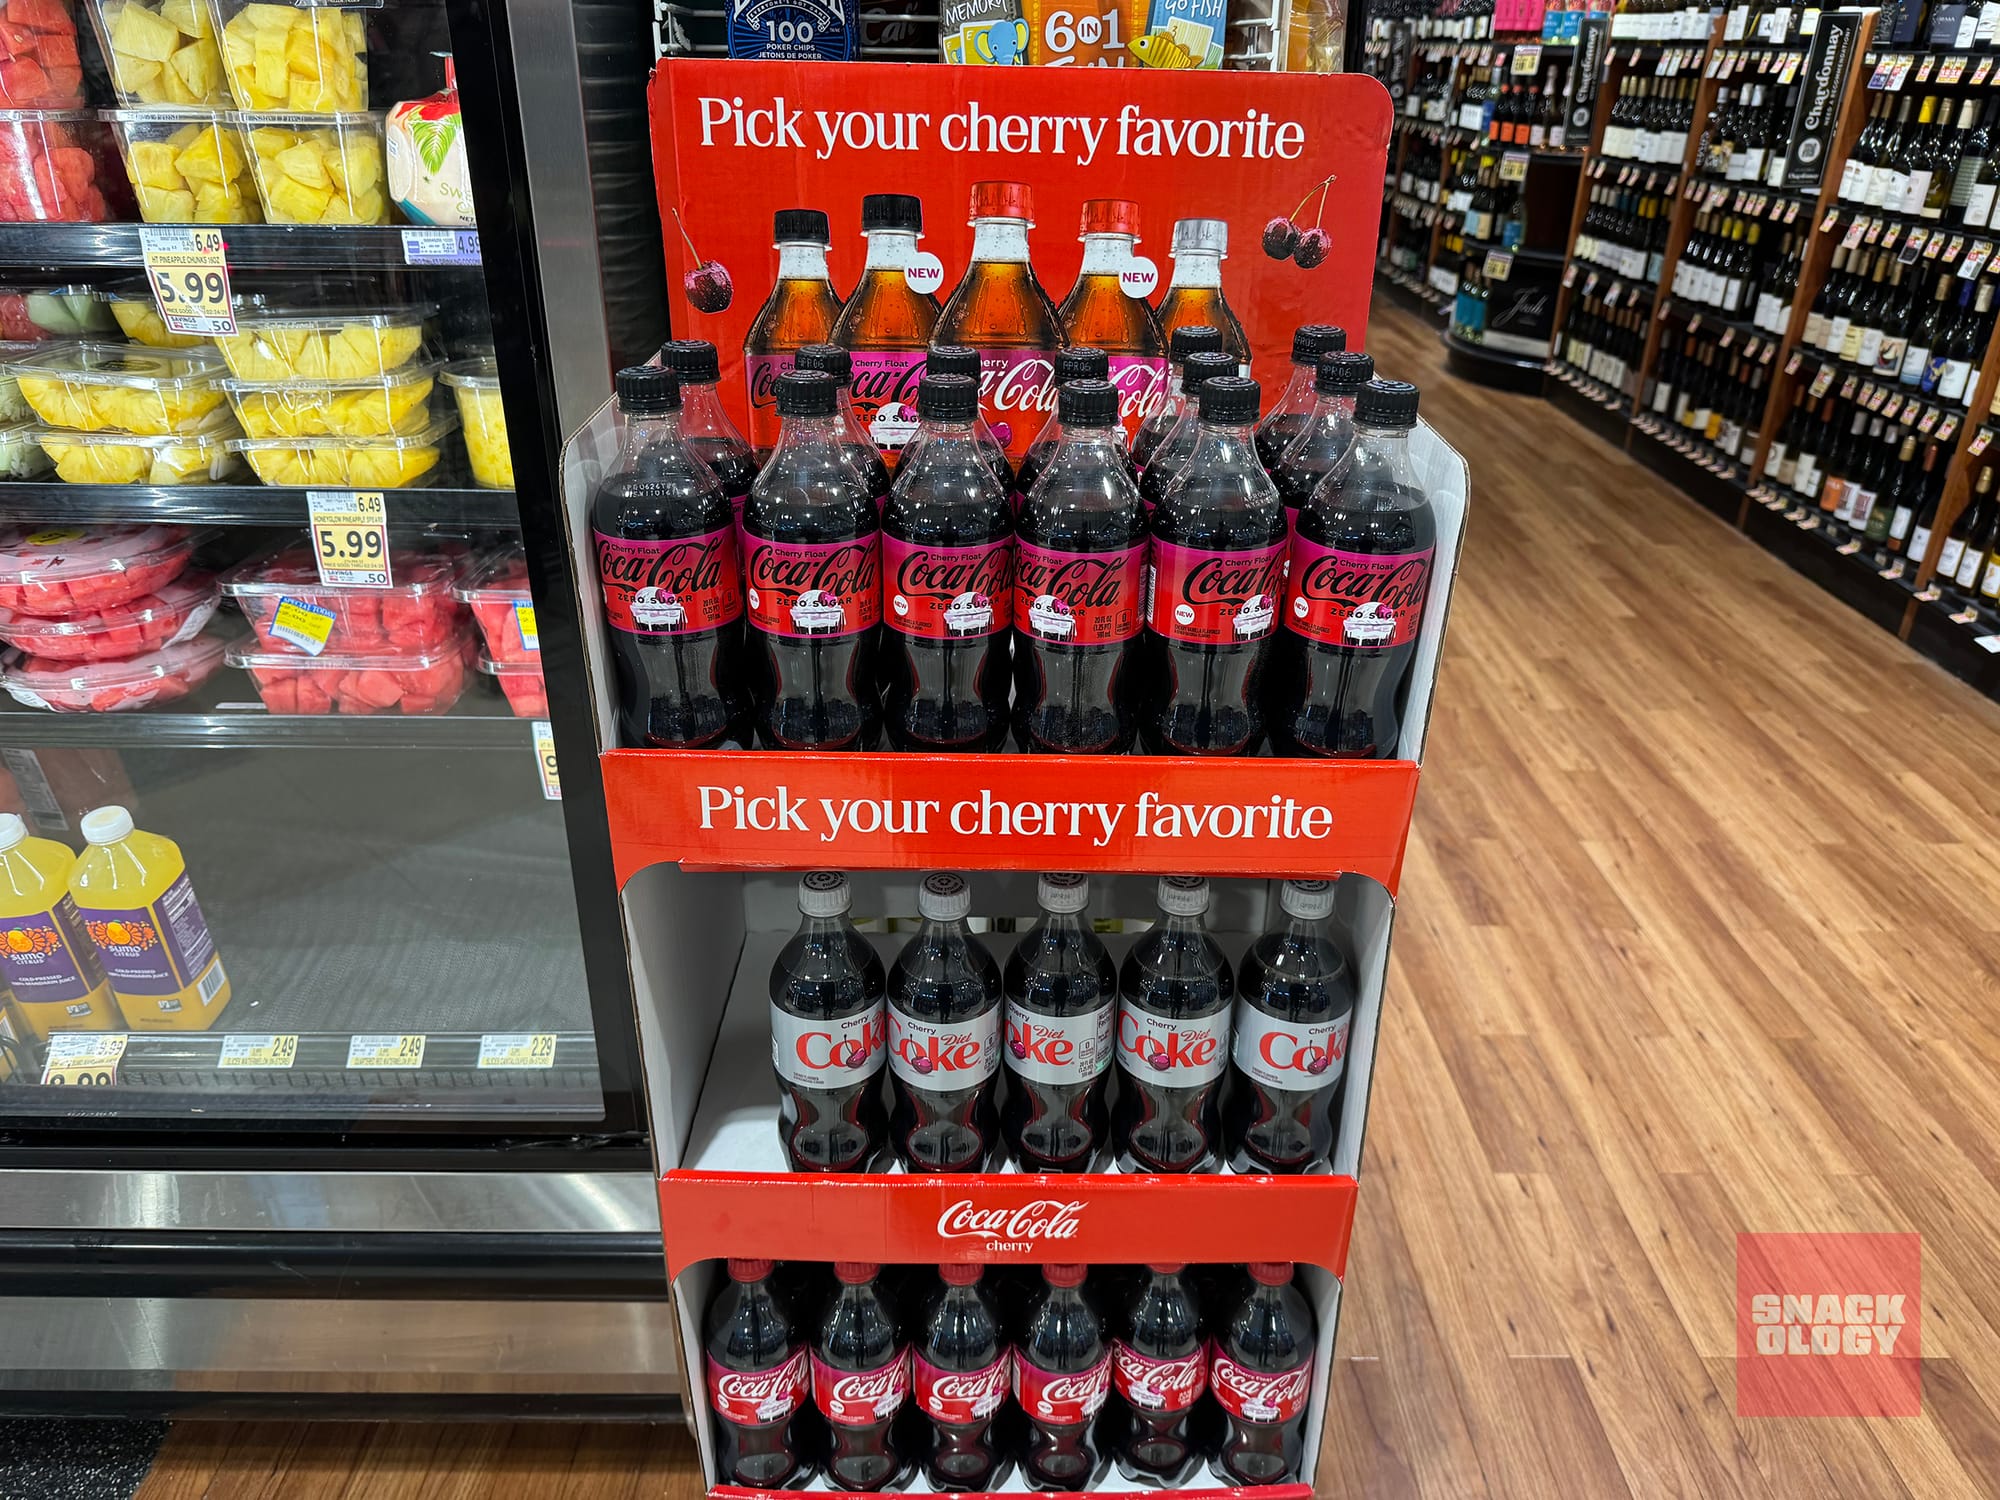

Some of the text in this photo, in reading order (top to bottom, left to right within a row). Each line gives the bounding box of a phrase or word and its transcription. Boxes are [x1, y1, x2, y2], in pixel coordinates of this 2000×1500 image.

[766, 21, 814, 43] 100
[1045, 9, 1125, 53] 6 IN 1
[1805, 24, 1843, 131] Chardonnay
[698, 96, 1305, 166] Pick your cherry favorite
[195, 233, 220, 252] 6.49
[907, 266, 940, 280] NEW
[1122, 271, 1155, 284] NEW
[157, 272, 225, 304] 5.99
[855, 360, 909, 369] Cherry Float
[856, 414, 886, 423] ZERO
[358, 496, 382, 512] 6.49
[320, 530, 382, 558] 5.99
[611, 544, 660, 555] Cherry Float
[775, 549, 802, 558] Cherry
[930, 553, 982, 563] Cherry Float
[1042, 556, 1063, 565] Float
[600, 537, 724, 595] Coca-Cola
[750, 540, 877, 598] Coca-Cola
[1225, 559, 1252, 567] Cherry
[1340, 559, 1369, 570] Cherry
[364, 573, 387, 584] .50
[617, 592, 693, 605] ZERO SUGAR
[776, 597, 852, 608] ZERO SUGAR
[929, 602, 961, 610] ZERO
[1046, 604, 1086, 617] SUGAR
[1219, 607, 1250, 616] ZERO
[1330, 607, 1406, 619] ZERO SUGAR
[1176, 610, 1193, 618] NEW
[697, 785, 1333, 847] Pick your cherry favorite
[1008, 1002, 1031, 1022] Cherry
[841, 1014, 870, 1030] Cherry
[907, 1021, 937, 1036] Cherry
[1146, 1017, 1177, 1032] Cherry
[1032, 1024, 1065, 1039] Diet
[1180, 1028, 1211, 1042] Diet
[1308, 1024, 1337, 1036] Cherry
[887, 1012, 982, 1072] Coke
[940, 1032, 973, 1046] Diet
[1119, 1009, 1217, 1068] Coke
[272, 1036, 295, 1057] 2.49
[399, 1036, 422, 1057] 2.49
[531, 1036, 553, 1057] 2.29
[937, 1200, 1089, 1239] Coca-Cola
[985, 1240, 1034, 1253] cherry
